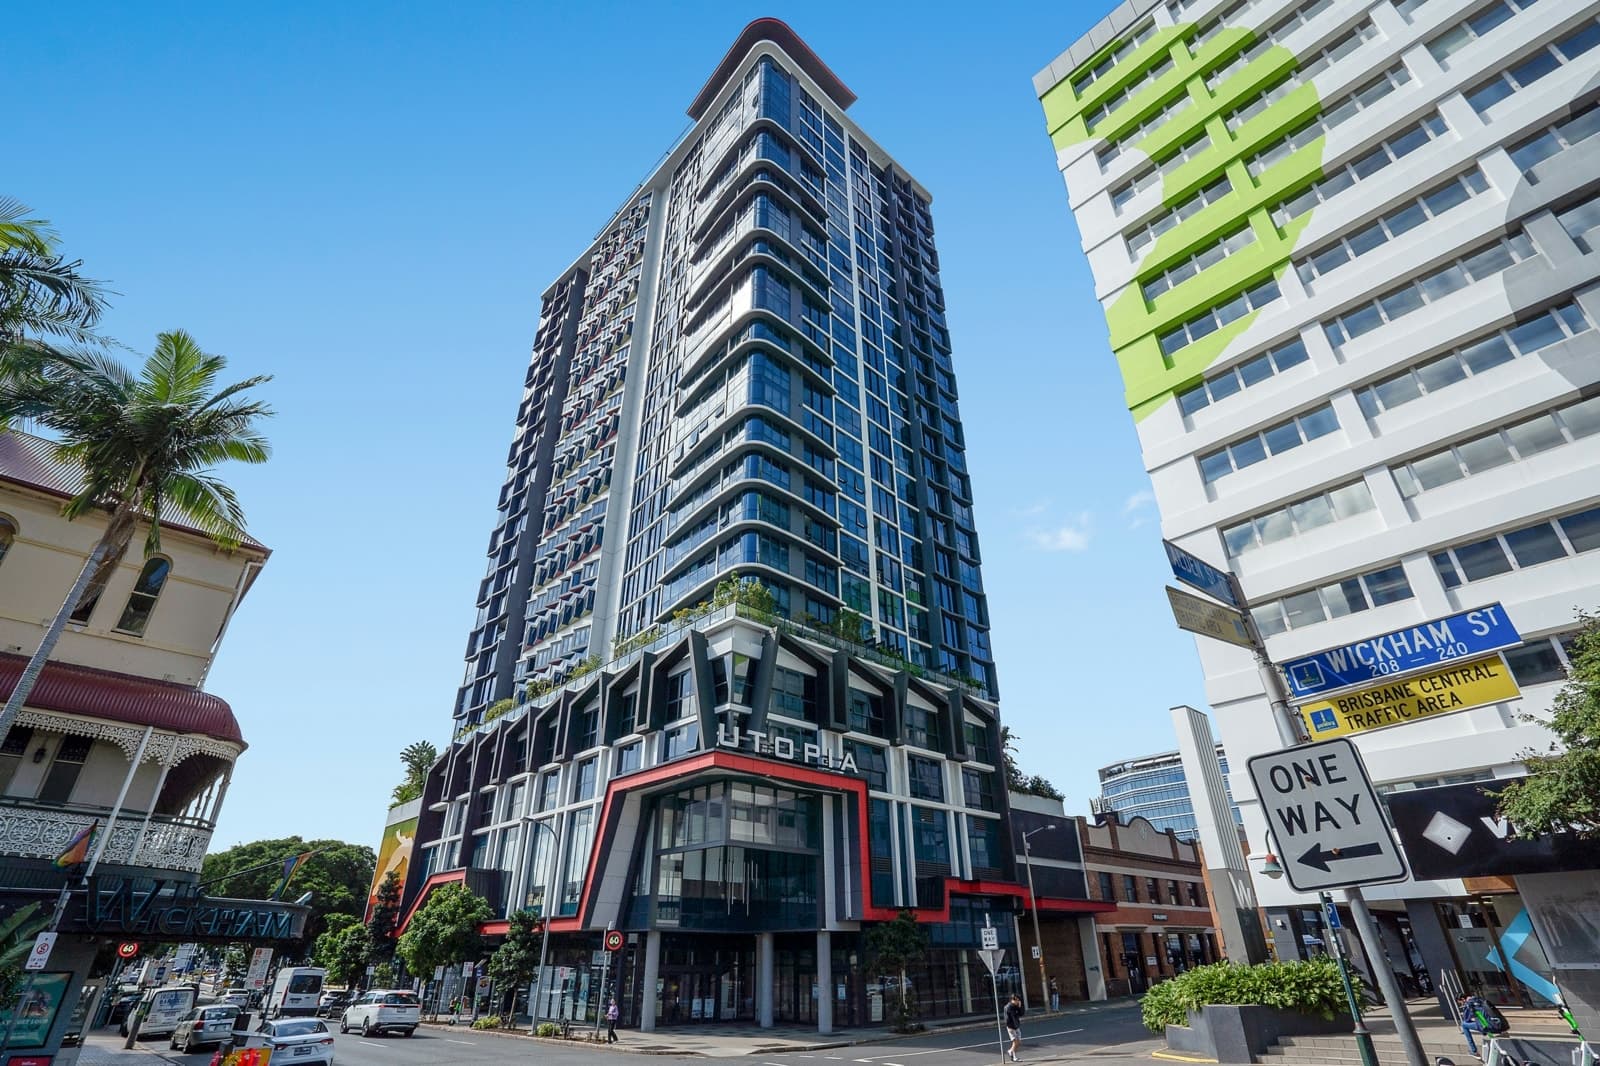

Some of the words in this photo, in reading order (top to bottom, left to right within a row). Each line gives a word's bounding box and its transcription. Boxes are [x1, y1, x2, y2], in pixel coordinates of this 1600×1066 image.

[1325, 620, 1456, 674] WICKHAM
[1466, 607, 1500, 637] ST
[1369, 659, 1400, 677] 208
[1436, 641, 1468, 661] 240
[1337, 682, 1416, 714] BRISBANE
[1419, 663, 1498, 694] CENTRAL
[1344, 703, 1411, 731] TRAFFIC
[1418, 692, 1463, 715] AREA
[717, 722, 859, 774] UTOPIA
[1269, 753, 1347, 794] ONE
[1276, 793, 1363, 838] WAY
[86, 874, 293, 938] WICKHAM
[123, 944, 134, 953] 60
[609, 936, 620, 945] 60
